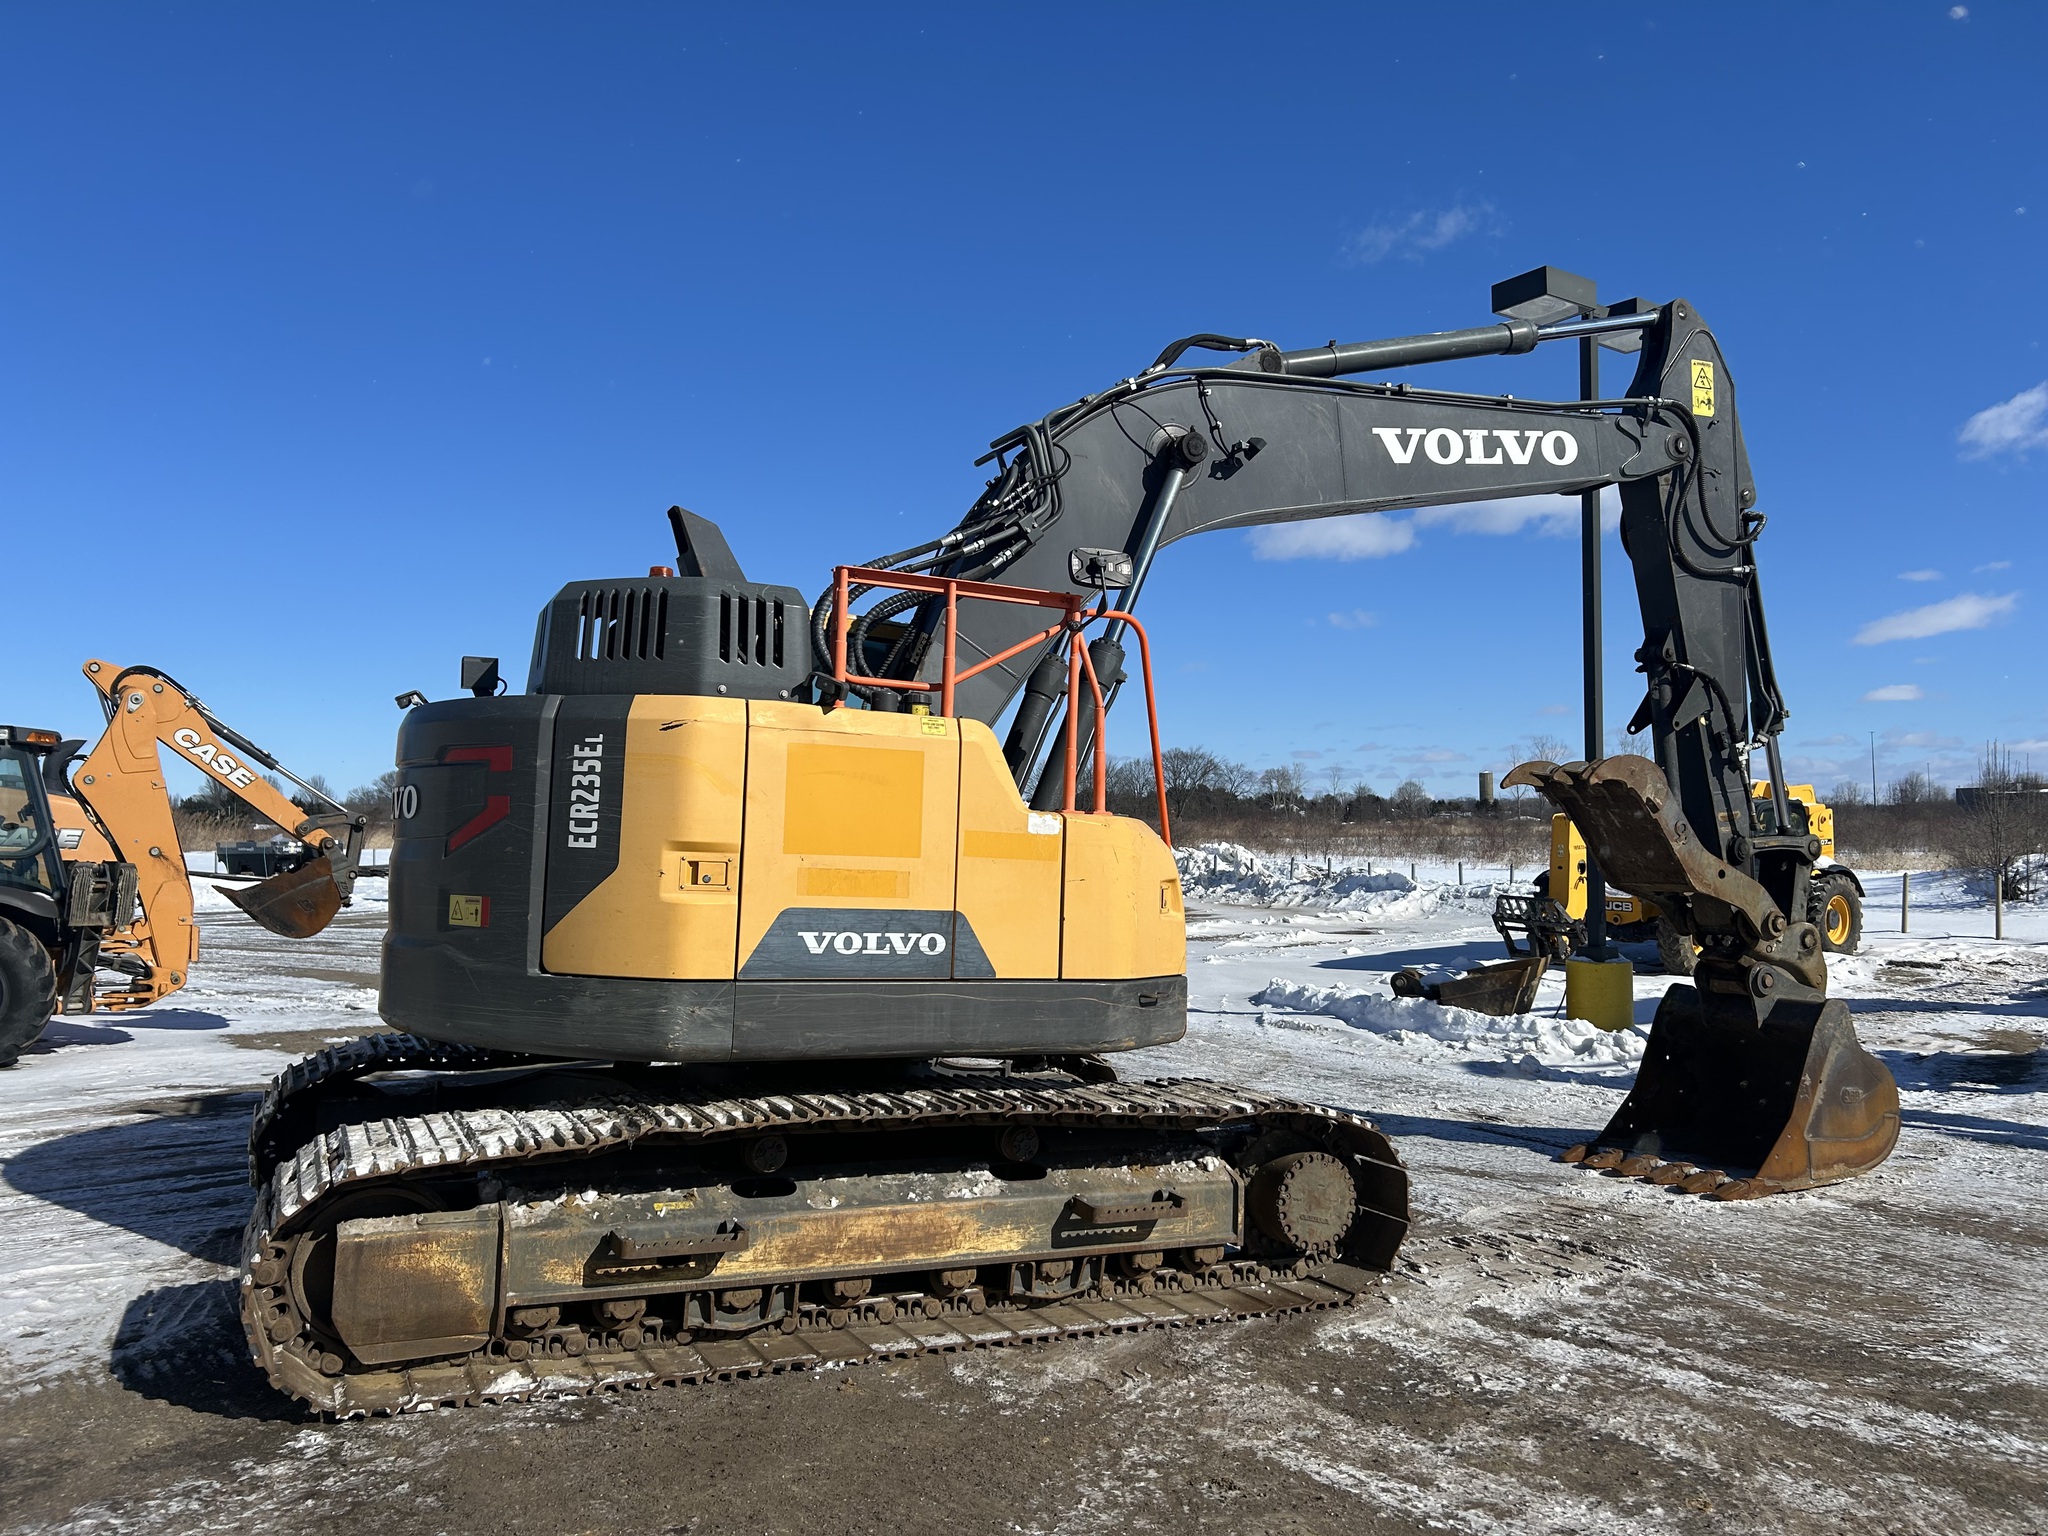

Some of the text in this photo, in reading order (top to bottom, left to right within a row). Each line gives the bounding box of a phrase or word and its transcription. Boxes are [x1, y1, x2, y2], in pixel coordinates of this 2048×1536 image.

[1372, 427, 1579, 466] VOLVO
[173, 727, 258, 789] CASE
[391, 785, 418, 820] VO
[567, 733, 604, 849] ECR235EL
[797, 931, 947, 956] VOLVO
